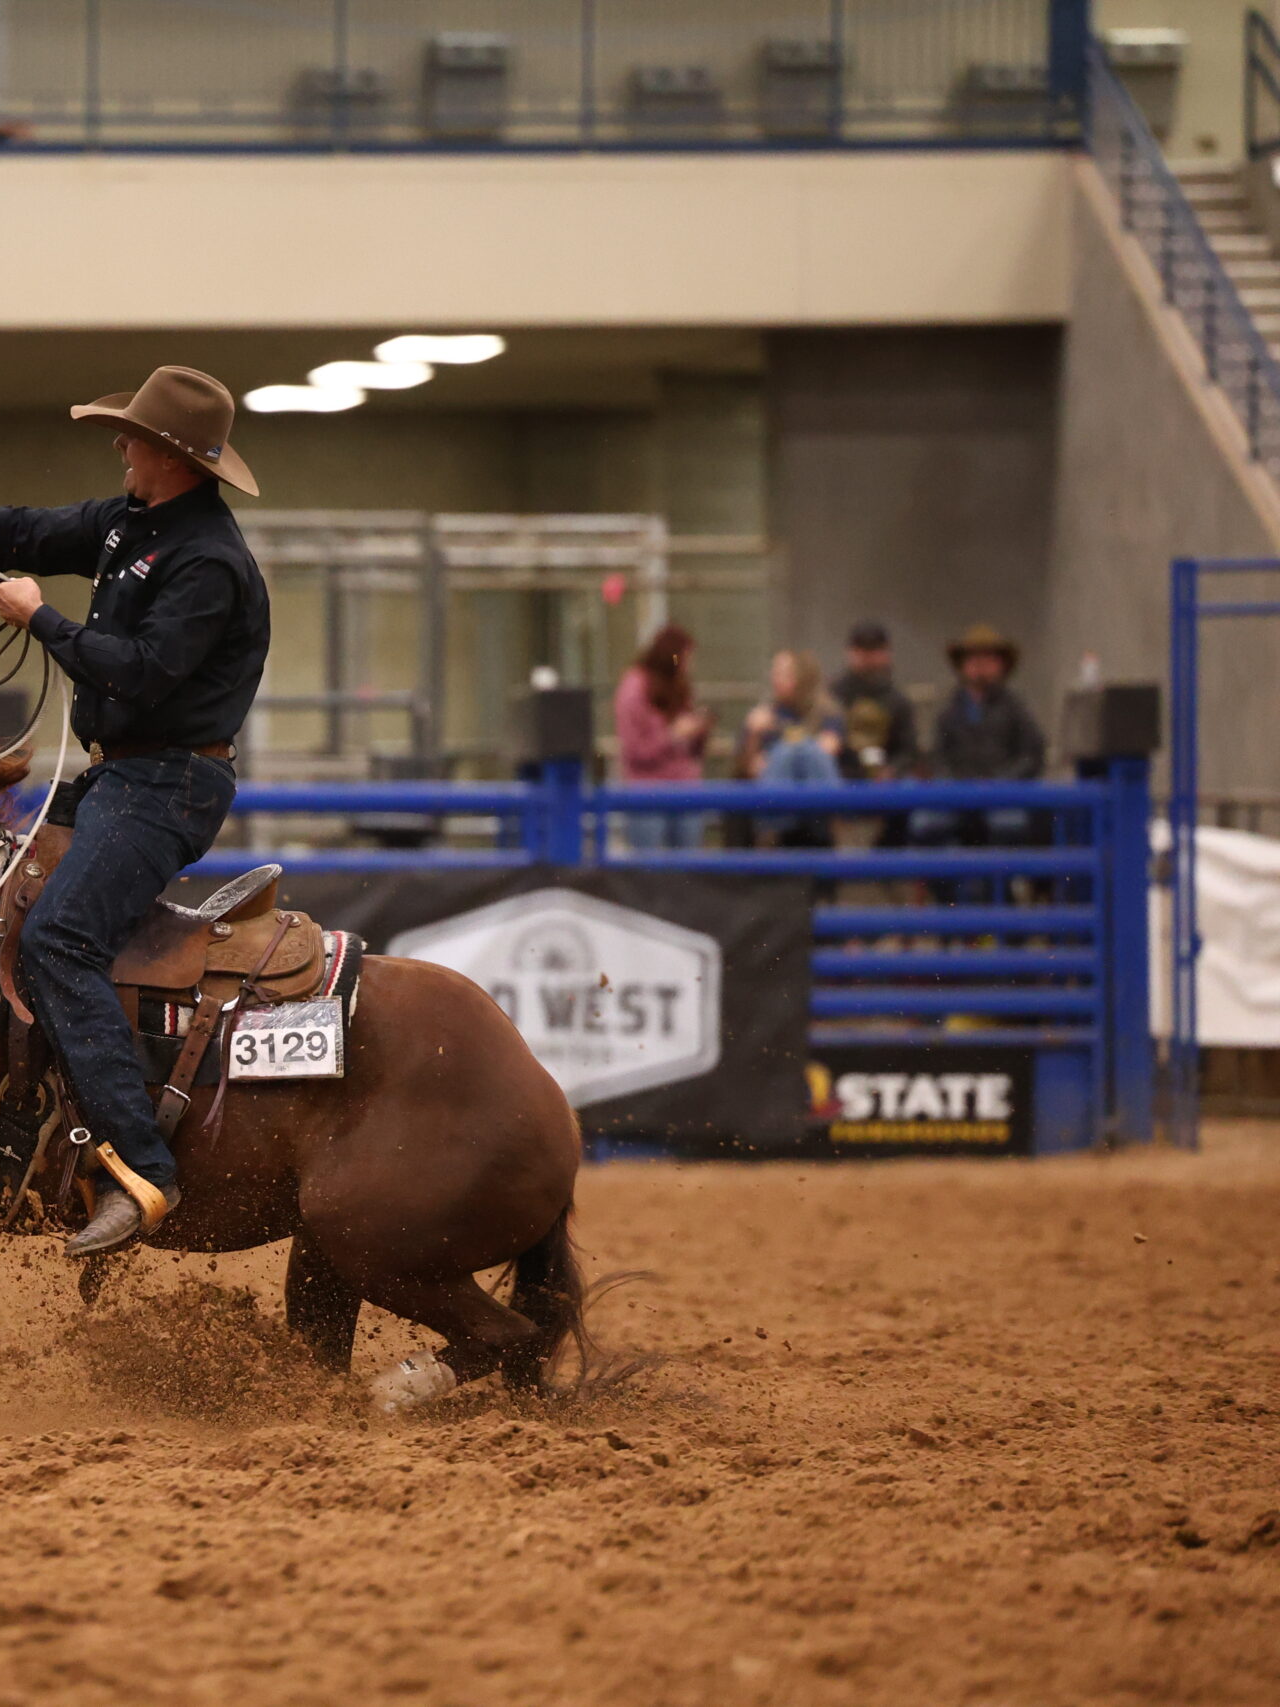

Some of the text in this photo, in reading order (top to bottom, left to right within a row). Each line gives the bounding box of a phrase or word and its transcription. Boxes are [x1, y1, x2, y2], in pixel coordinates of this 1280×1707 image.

[538, 982, 680, 1037] WEST
[235, 1030, 328, 1065] 3129
[836, 1073, 1012, 1121] STATE
